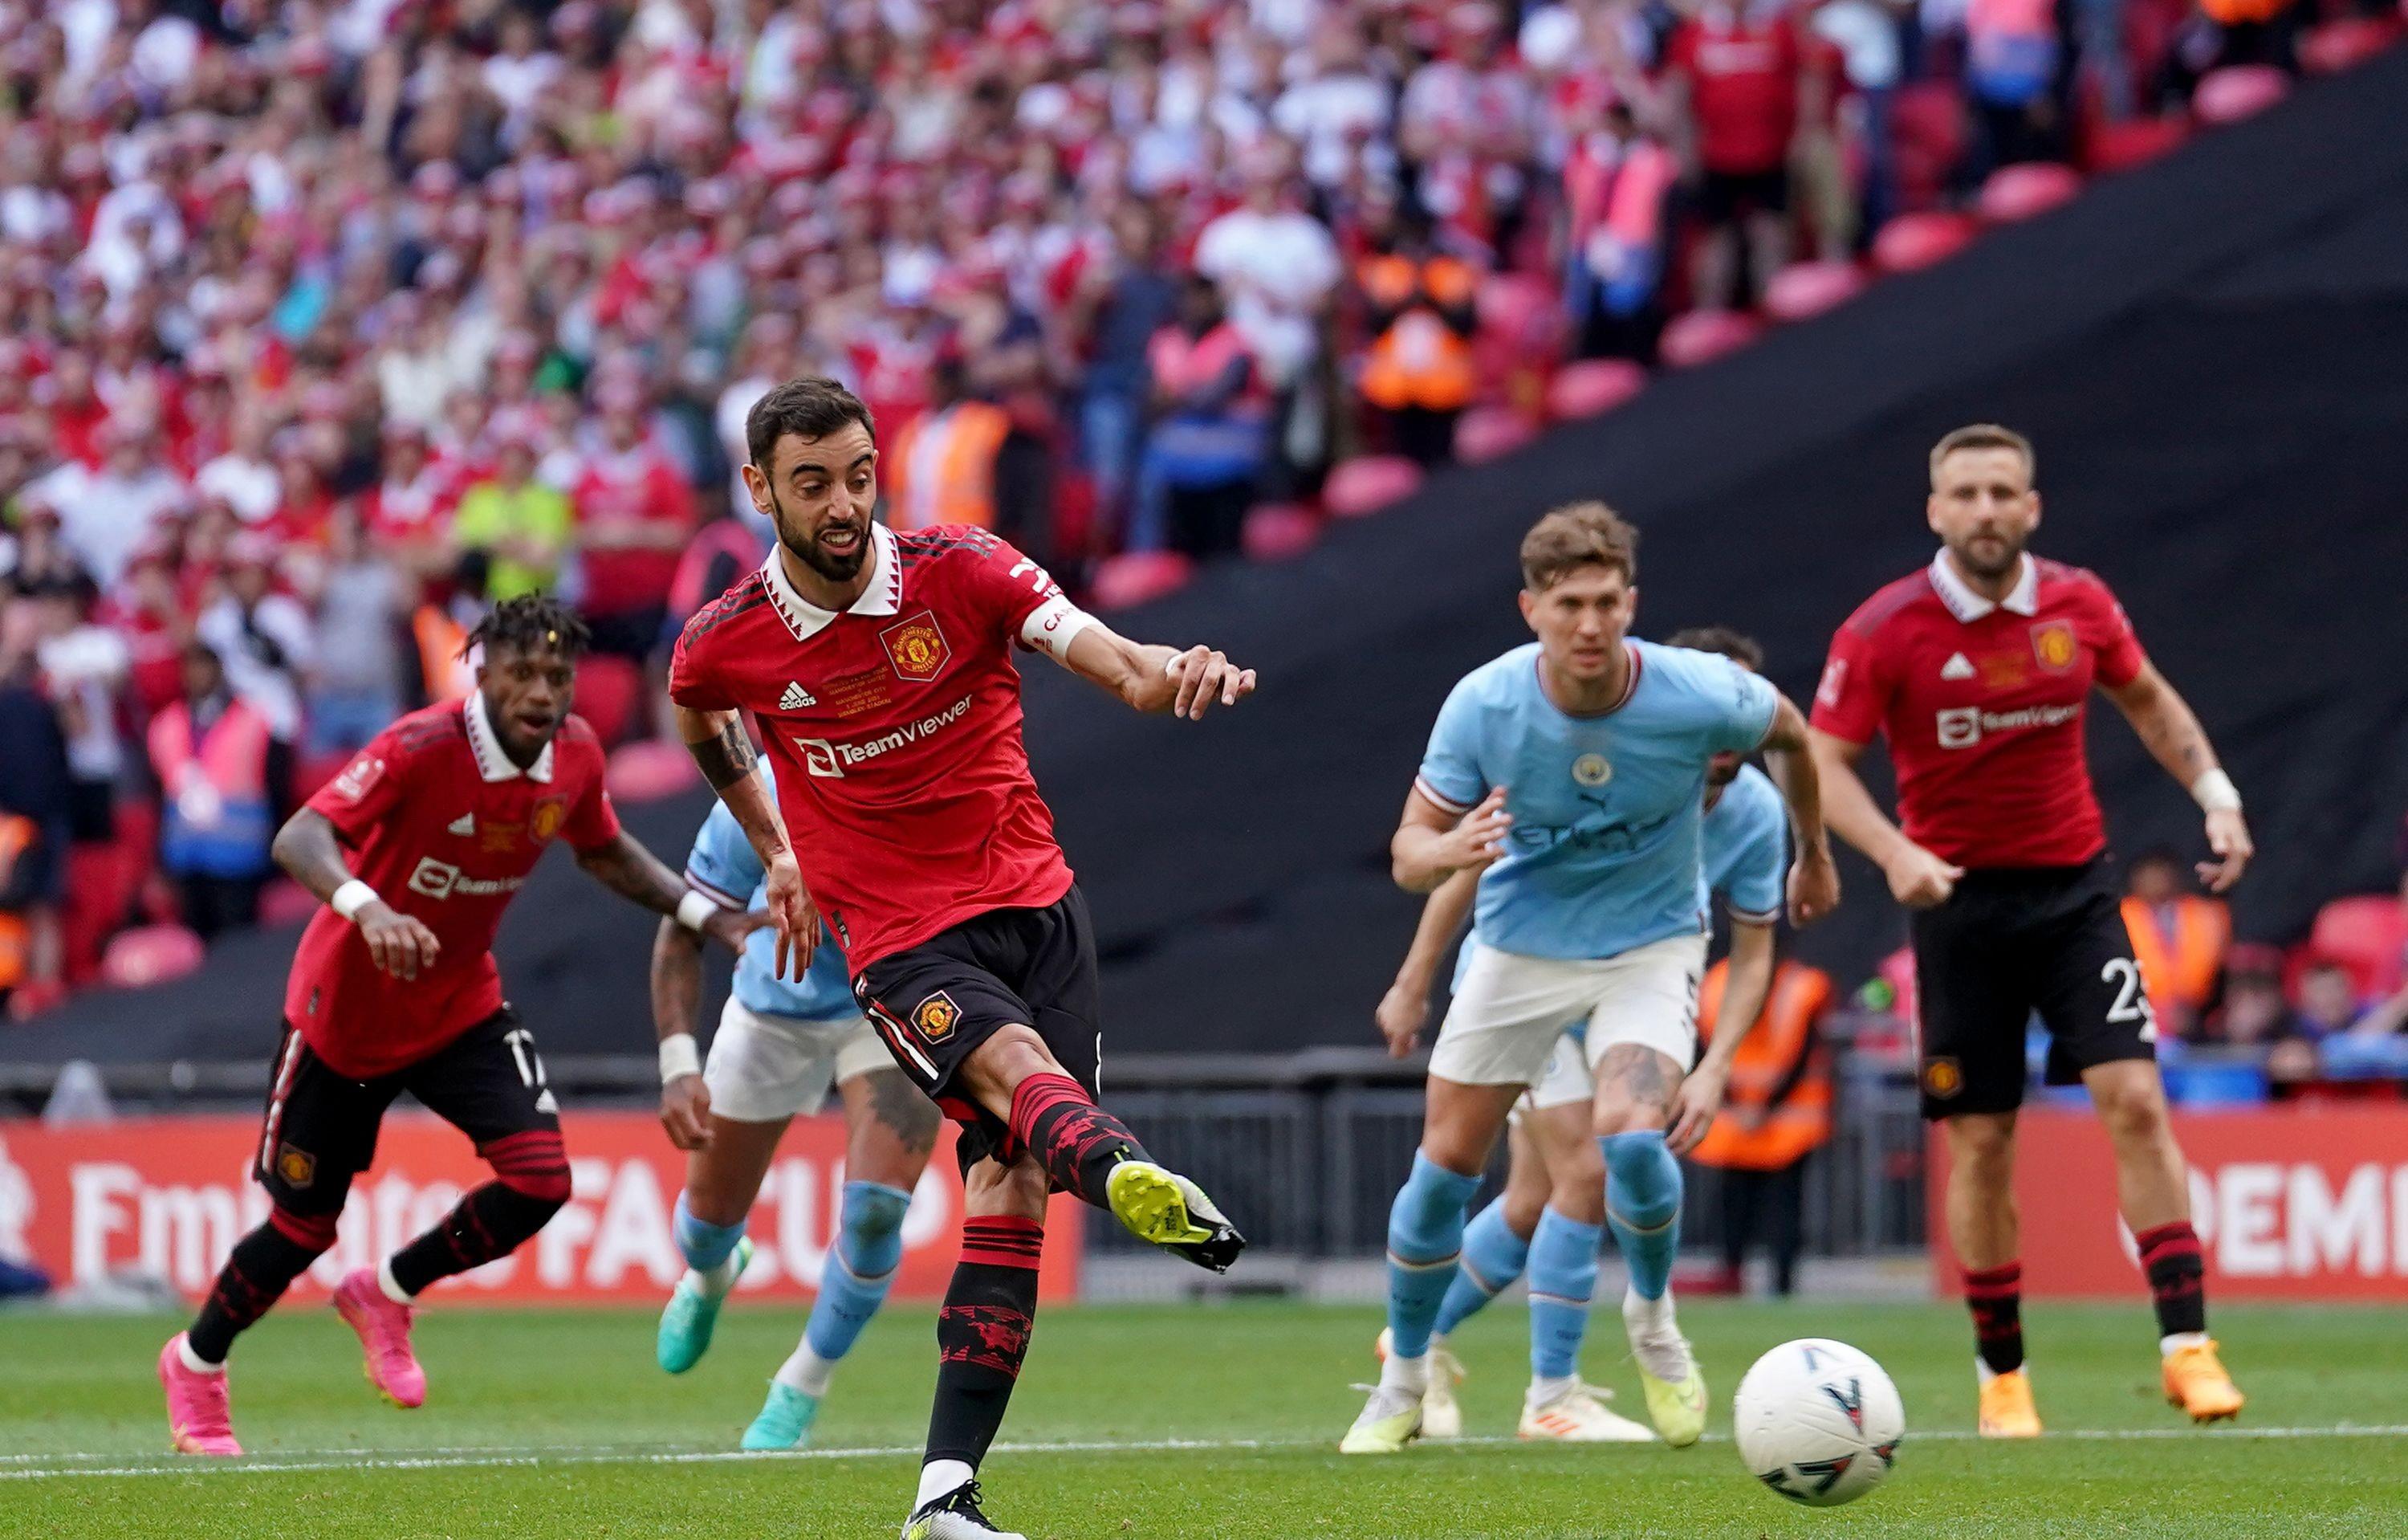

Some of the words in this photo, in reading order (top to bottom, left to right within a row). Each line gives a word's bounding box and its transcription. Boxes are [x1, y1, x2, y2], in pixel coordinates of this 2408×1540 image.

[779, 695, 817, 710] adidas
[836, 694, 973, 766] TeamViewer
[537, 1156, 684, 1289] FA
